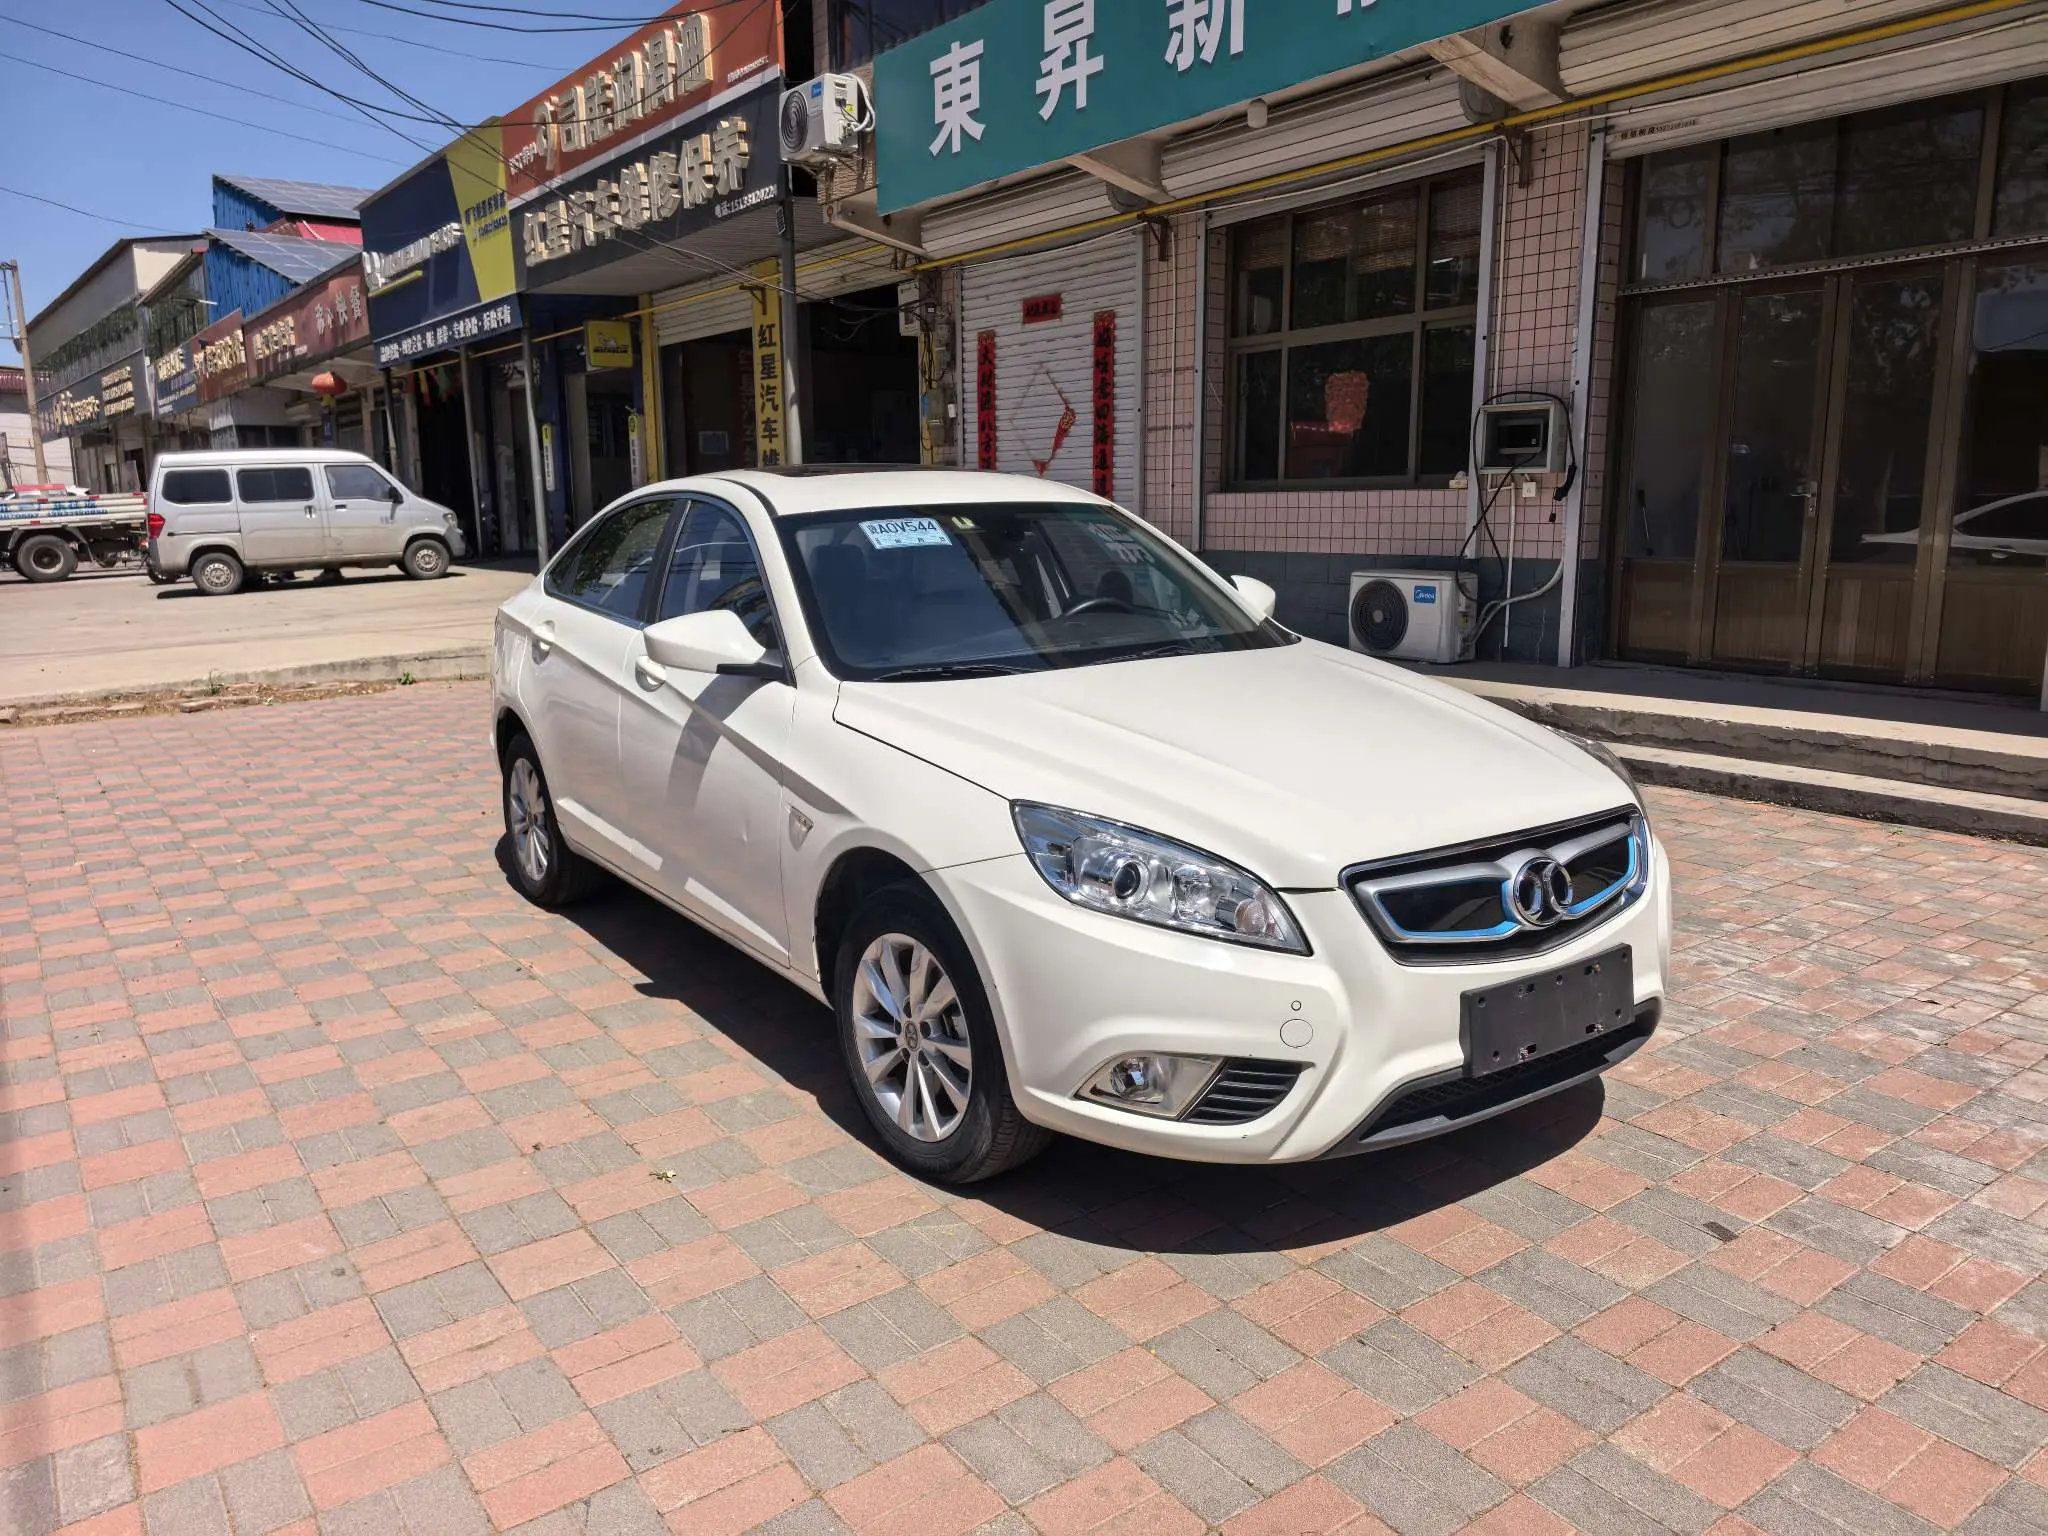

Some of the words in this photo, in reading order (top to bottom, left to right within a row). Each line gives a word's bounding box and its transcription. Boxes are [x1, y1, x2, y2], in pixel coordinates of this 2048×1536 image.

[928, 0, 1376, 157] 東昇新
[523, 115, 751, 267] 红星汽车维修保养
[758, 322, 780, 466] 红星汽车维
